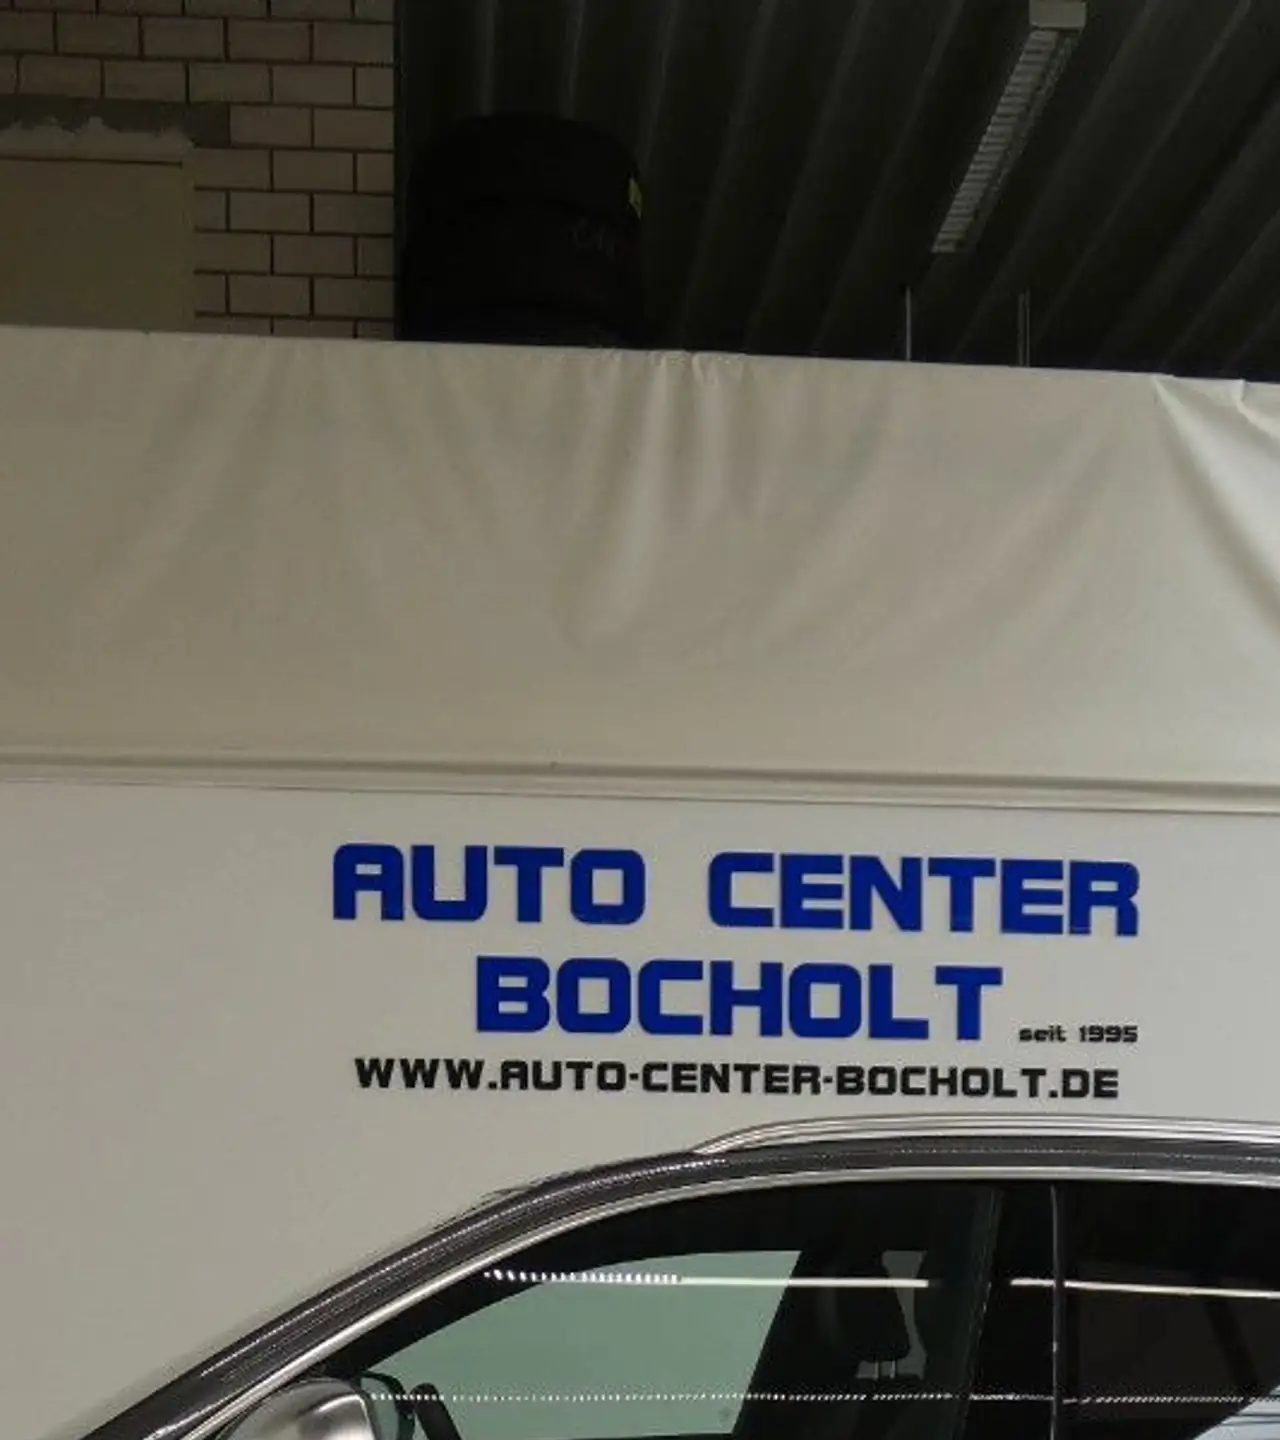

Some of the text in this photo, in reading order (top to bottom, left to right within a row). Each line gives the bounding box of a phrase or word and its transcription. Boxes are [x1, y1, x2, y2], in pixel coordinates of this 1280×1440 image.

[331, 842, 1141, 937] AUTO CENTER
[475, 955, 1004, 1041] BOCHOLT
[1018, 1024, 1139, 1043] seit 1995
[353, 1057, 1120, 1099] WWW.AUTO-CENTER-BOCHOLT.DE
